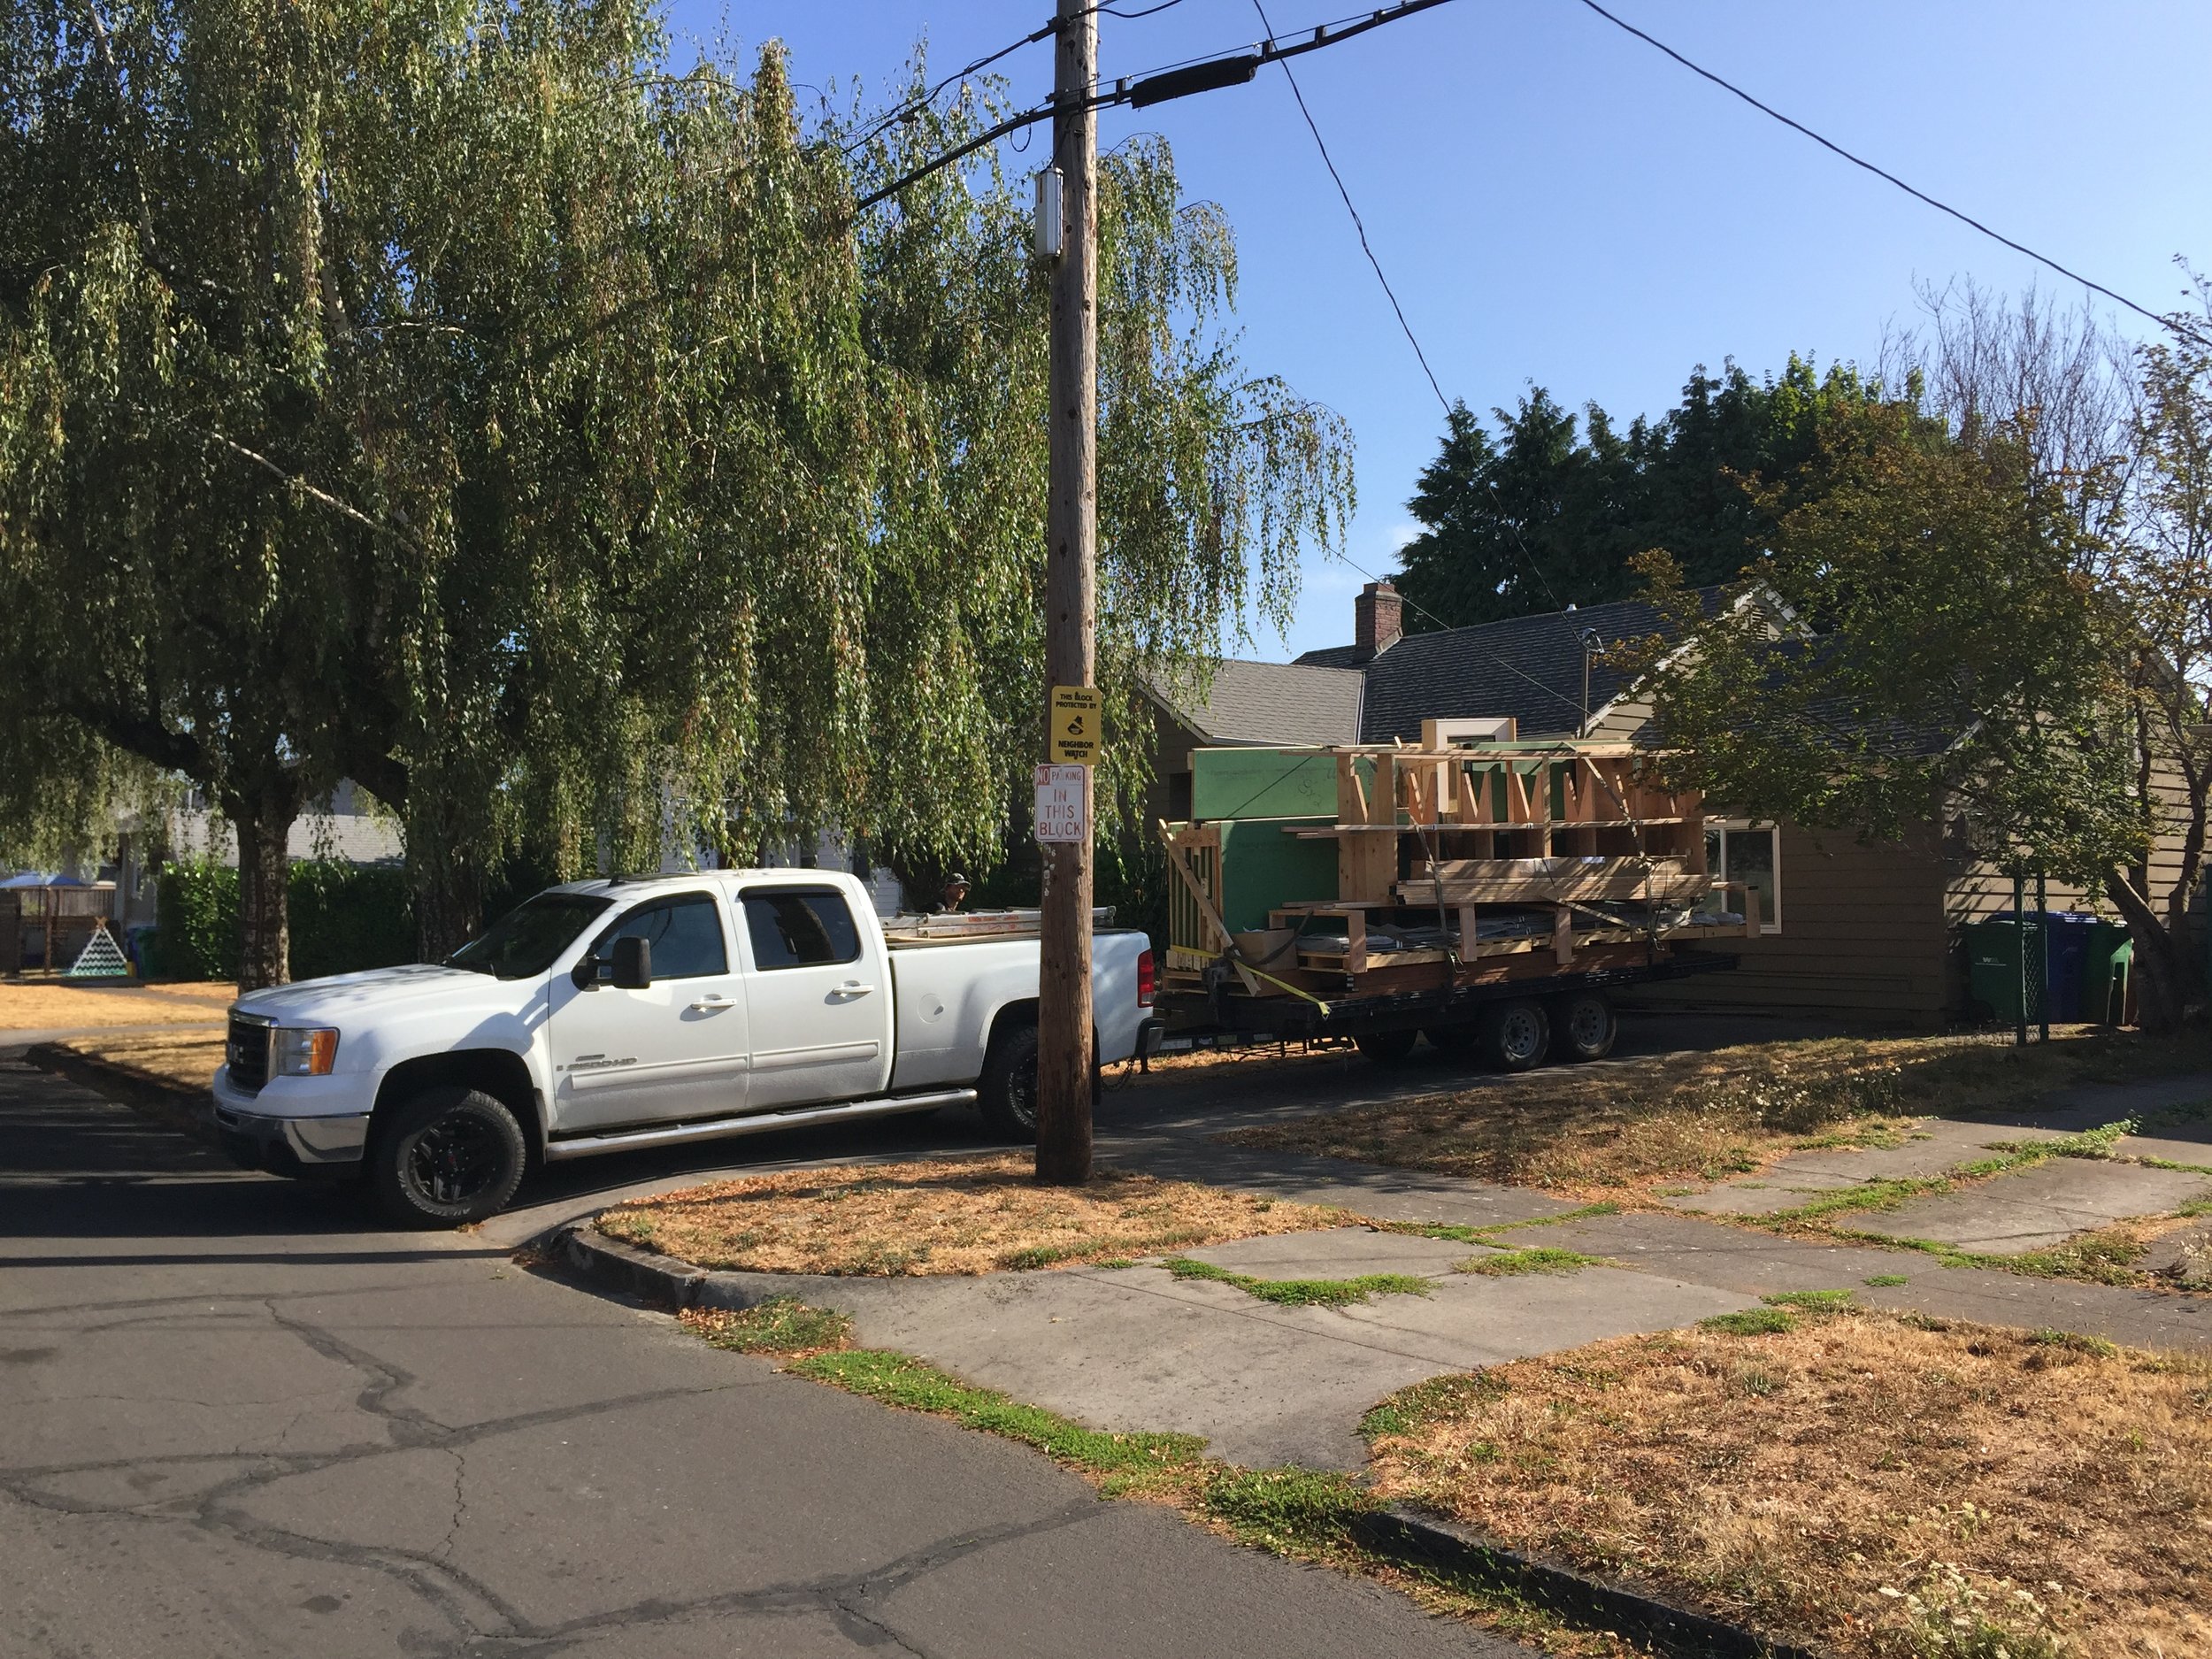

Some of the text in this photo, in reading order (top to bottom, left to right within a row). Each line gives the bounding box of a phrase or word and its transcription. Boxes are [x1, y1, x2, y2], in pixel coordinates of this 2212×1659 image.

[1038, 768, 1081, 783] NO PAKING
[1054, 788, 1067, 803] IN
[1045, 804, 1074, 818] THIS
[1040, 821, 1081, 836] BLOCK
